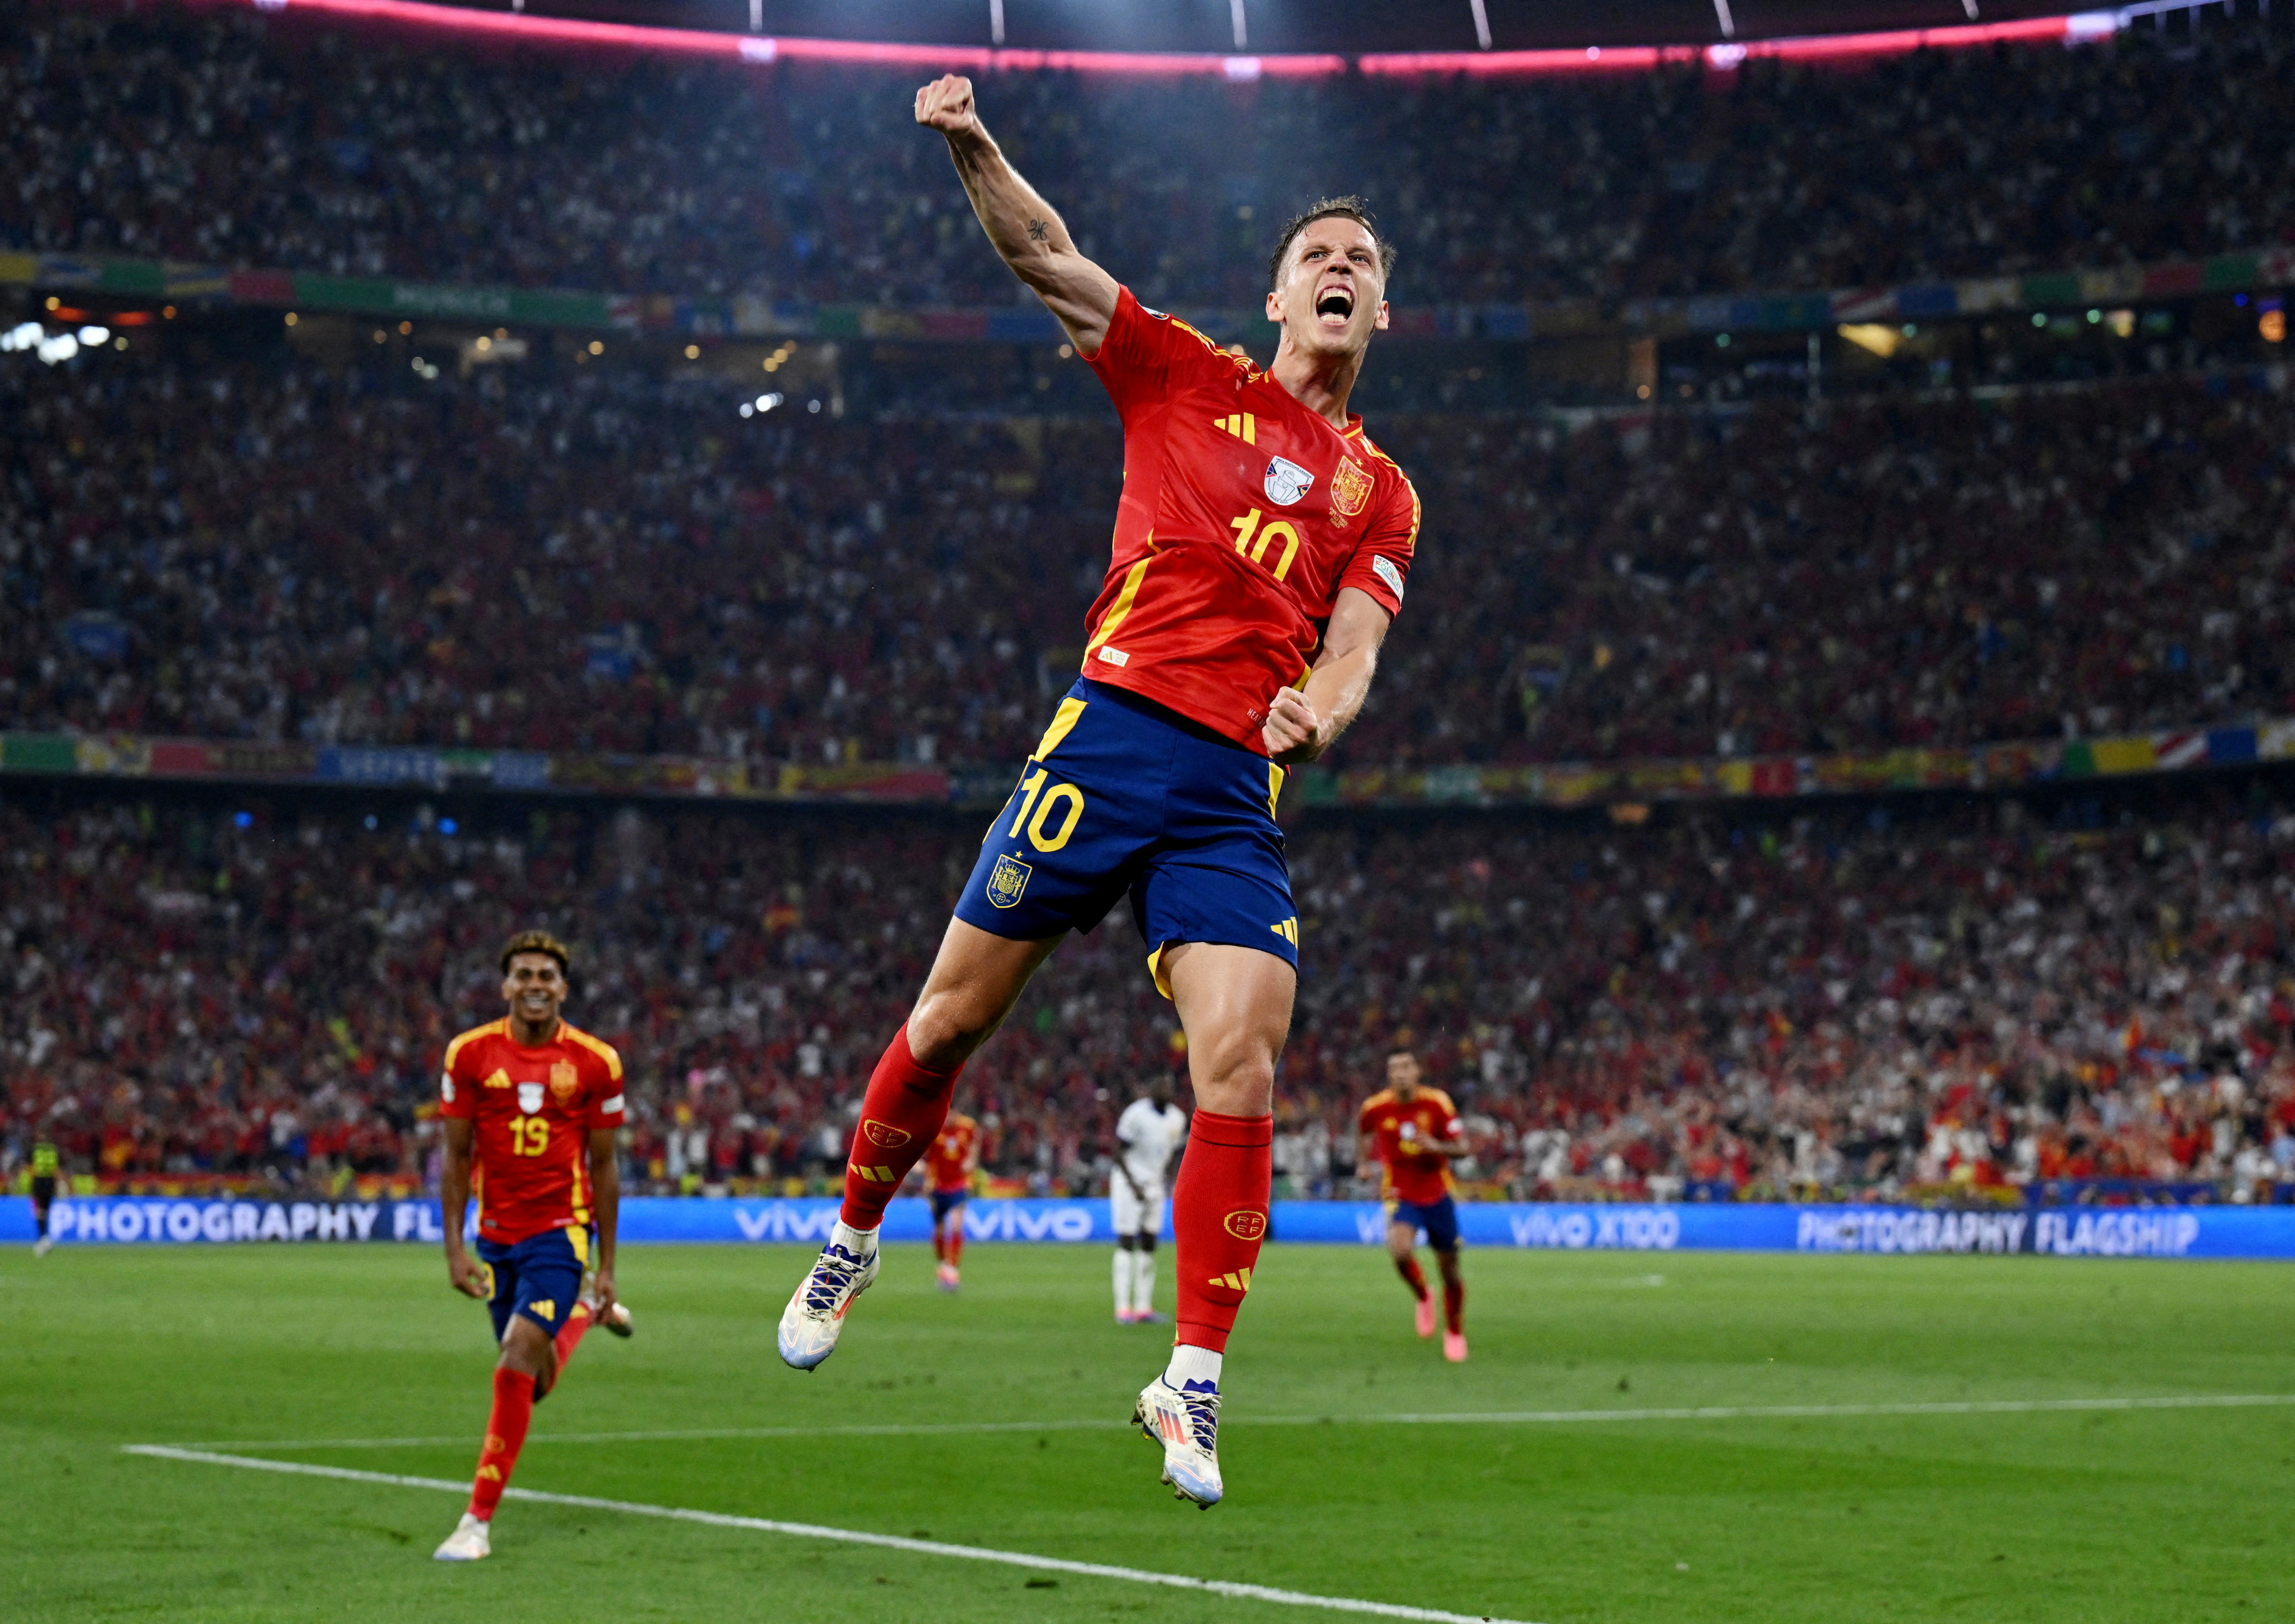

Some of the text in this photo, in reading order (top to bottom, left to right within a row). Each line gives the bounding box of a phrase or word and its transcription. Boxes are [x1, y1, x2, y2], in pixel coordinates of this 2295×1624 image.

[1230, 507, 1299, 582] 10
[1376, 556, 1389, 565] UEFA
[1008, 768, 1085, 852] 10
[508, 1114, 550, 1157] 19
[49, 1201, 379, 1241] PHOTOGRAPHY
[1797, 1211, 2199, 1256] PHOTOGRAPHY FLAGSHIP
